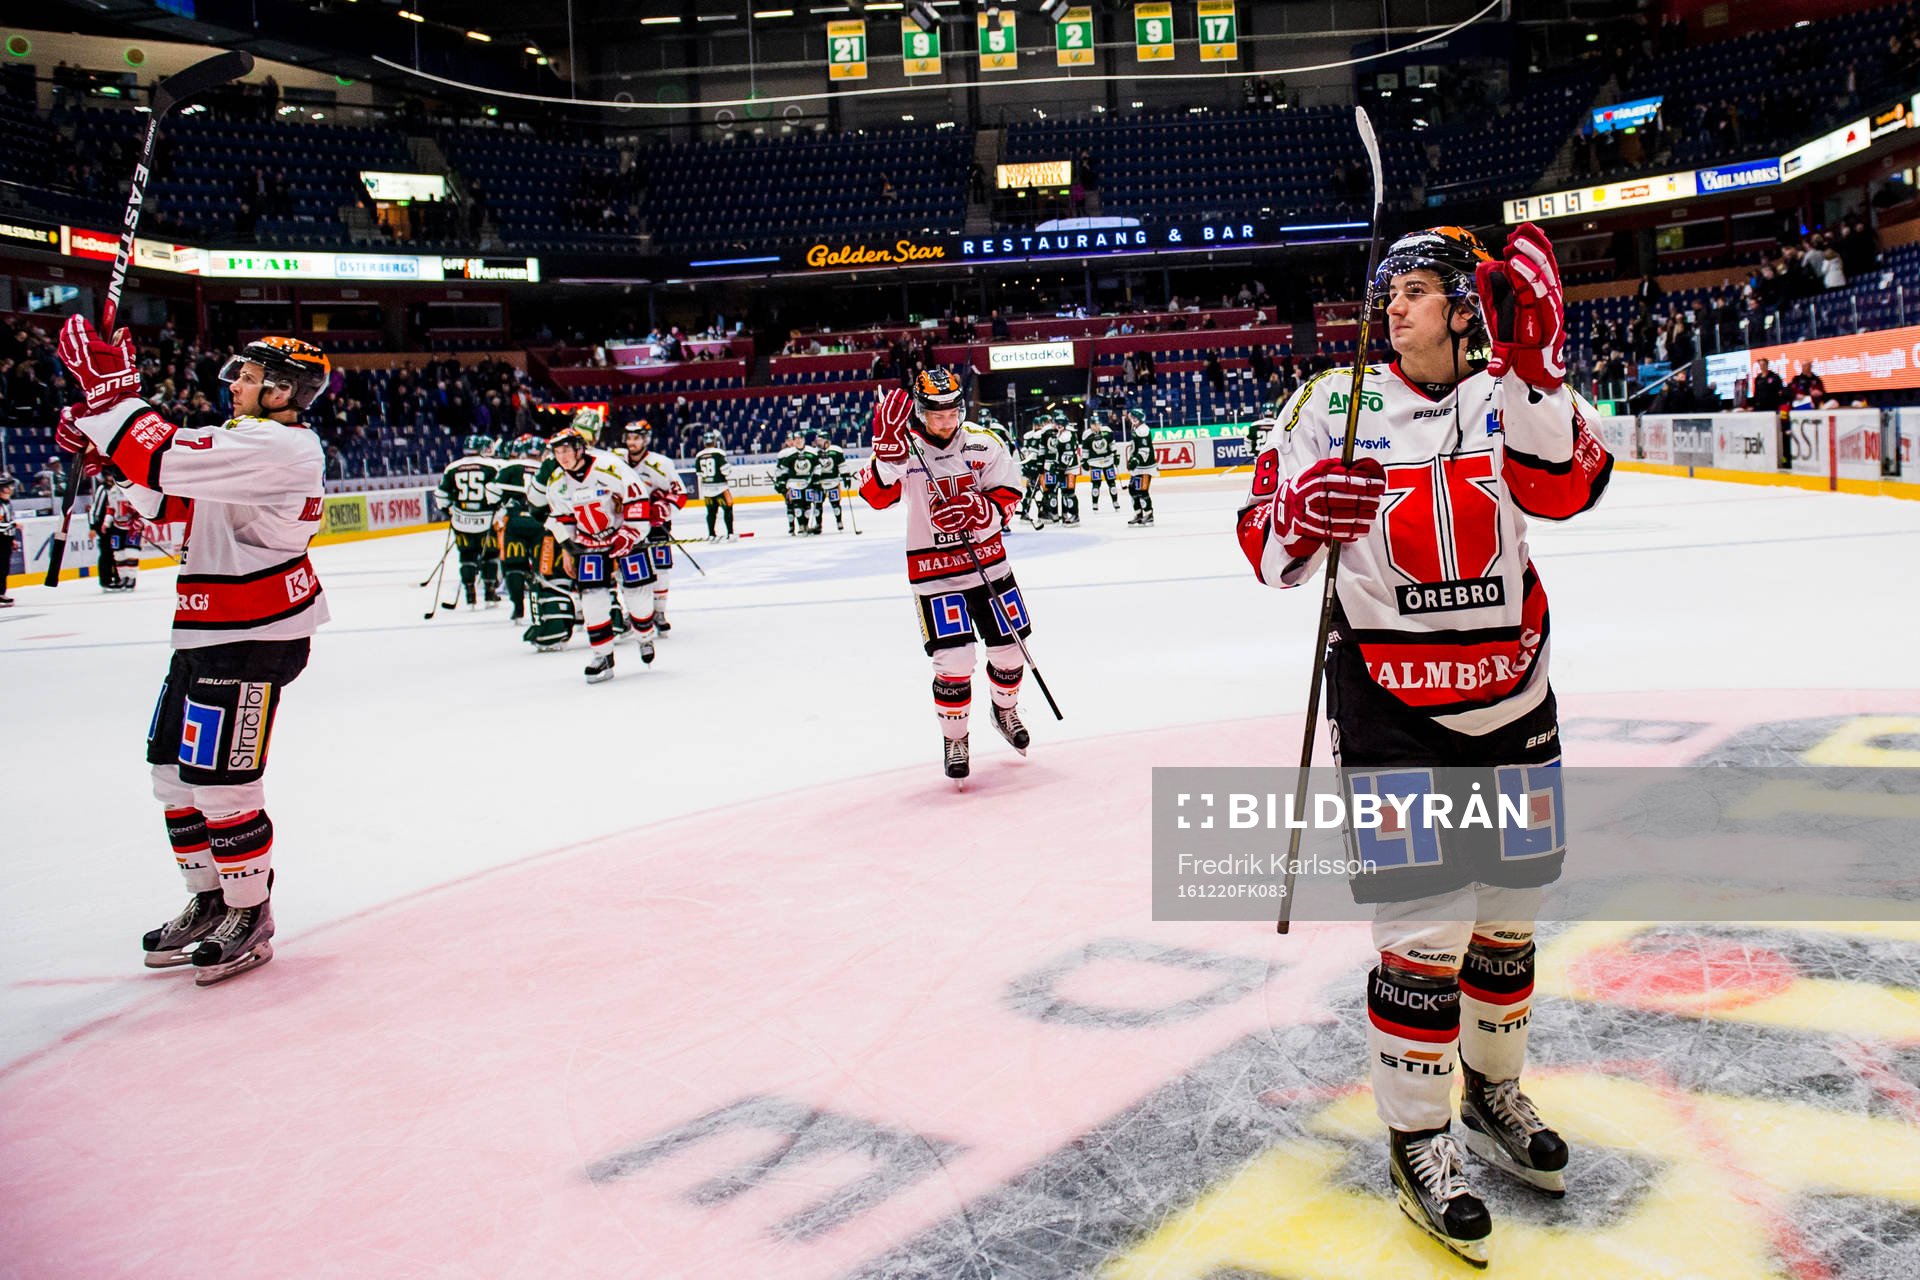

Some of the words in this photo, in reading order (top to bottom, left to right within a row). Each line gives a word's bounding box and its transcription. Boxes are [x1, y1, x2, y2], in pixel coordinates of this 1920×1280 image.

[989, 30, 1006, 52] 5
[1066, 24, 1084, 48] 2
[1146, 19, 1163, 43] 9
[1205, 18, 1229, 41] 17
[834, 37, 861, 62] 21
[913, 33, 930, 57] 9
[107, 162, 150, 304] EASTON
[806, 243, 892, 268] Golden
[893, 240, 945, 262] Star
[963, 230, 1147, 255] RESTAURANG
[1168, 228, 1182, 242] &
[1203, 224, 1254, 241] BAR
[227, 257, 300, 272] PEAB
[991, 347, 1070, 363] CarlstadKok
[1413, 407, 1453, 420] BAUE
[1252, 448, 1279, 496] 8
[455, 471, 485, 501] 55
[329, 503, 361, 526] ENERGI
[389, 498, 422, 520] SYNS
[1405, 583, 1500, 610] ÖREBRO
[229, 683, 264, 769] Structor
